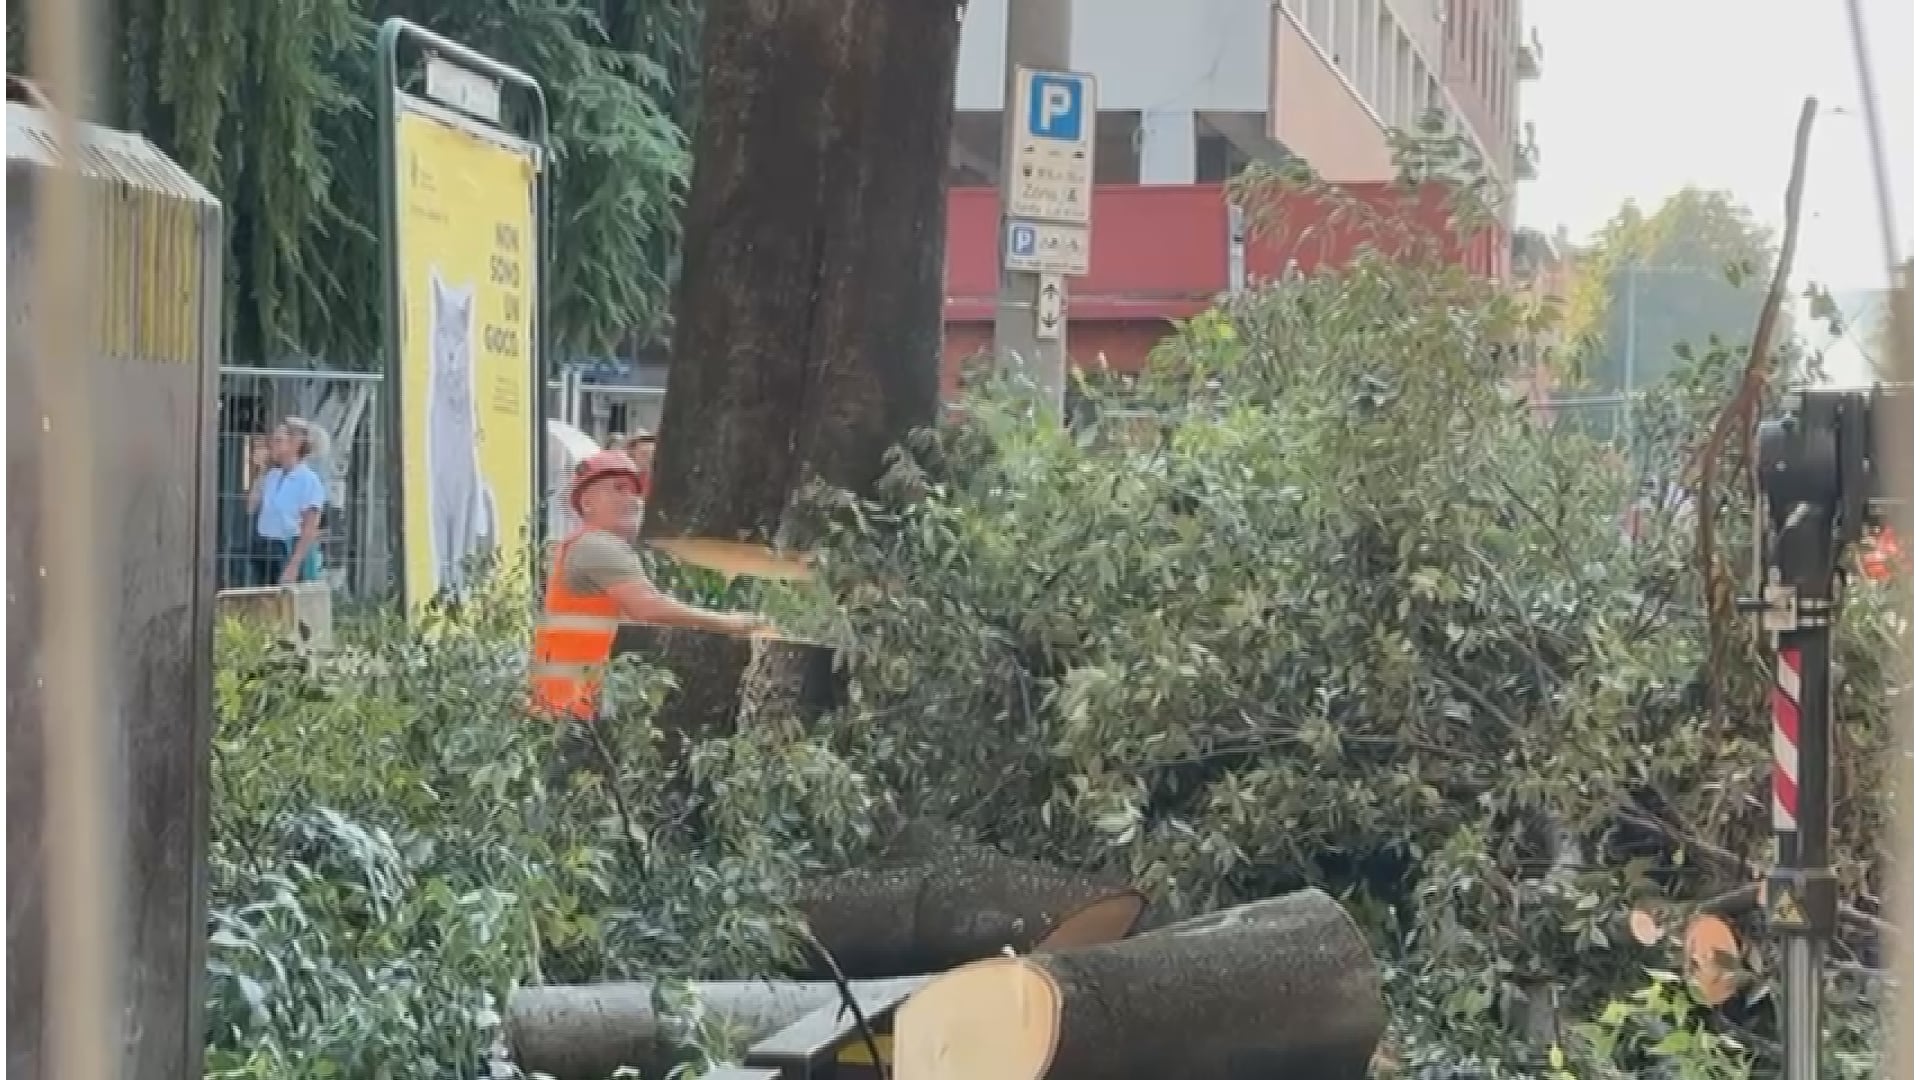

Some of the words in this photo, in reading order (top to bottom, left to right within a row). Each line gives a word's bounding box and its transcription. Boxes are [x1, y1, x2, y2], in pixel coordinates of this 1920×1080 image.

[1040, 84, 1072, 131] P
[496, 222, 520, 253] NON
[1015, 229, 1032, 253] P
[489, 254, 520, 289] SONO
[503, 292, 520, 324] UN
